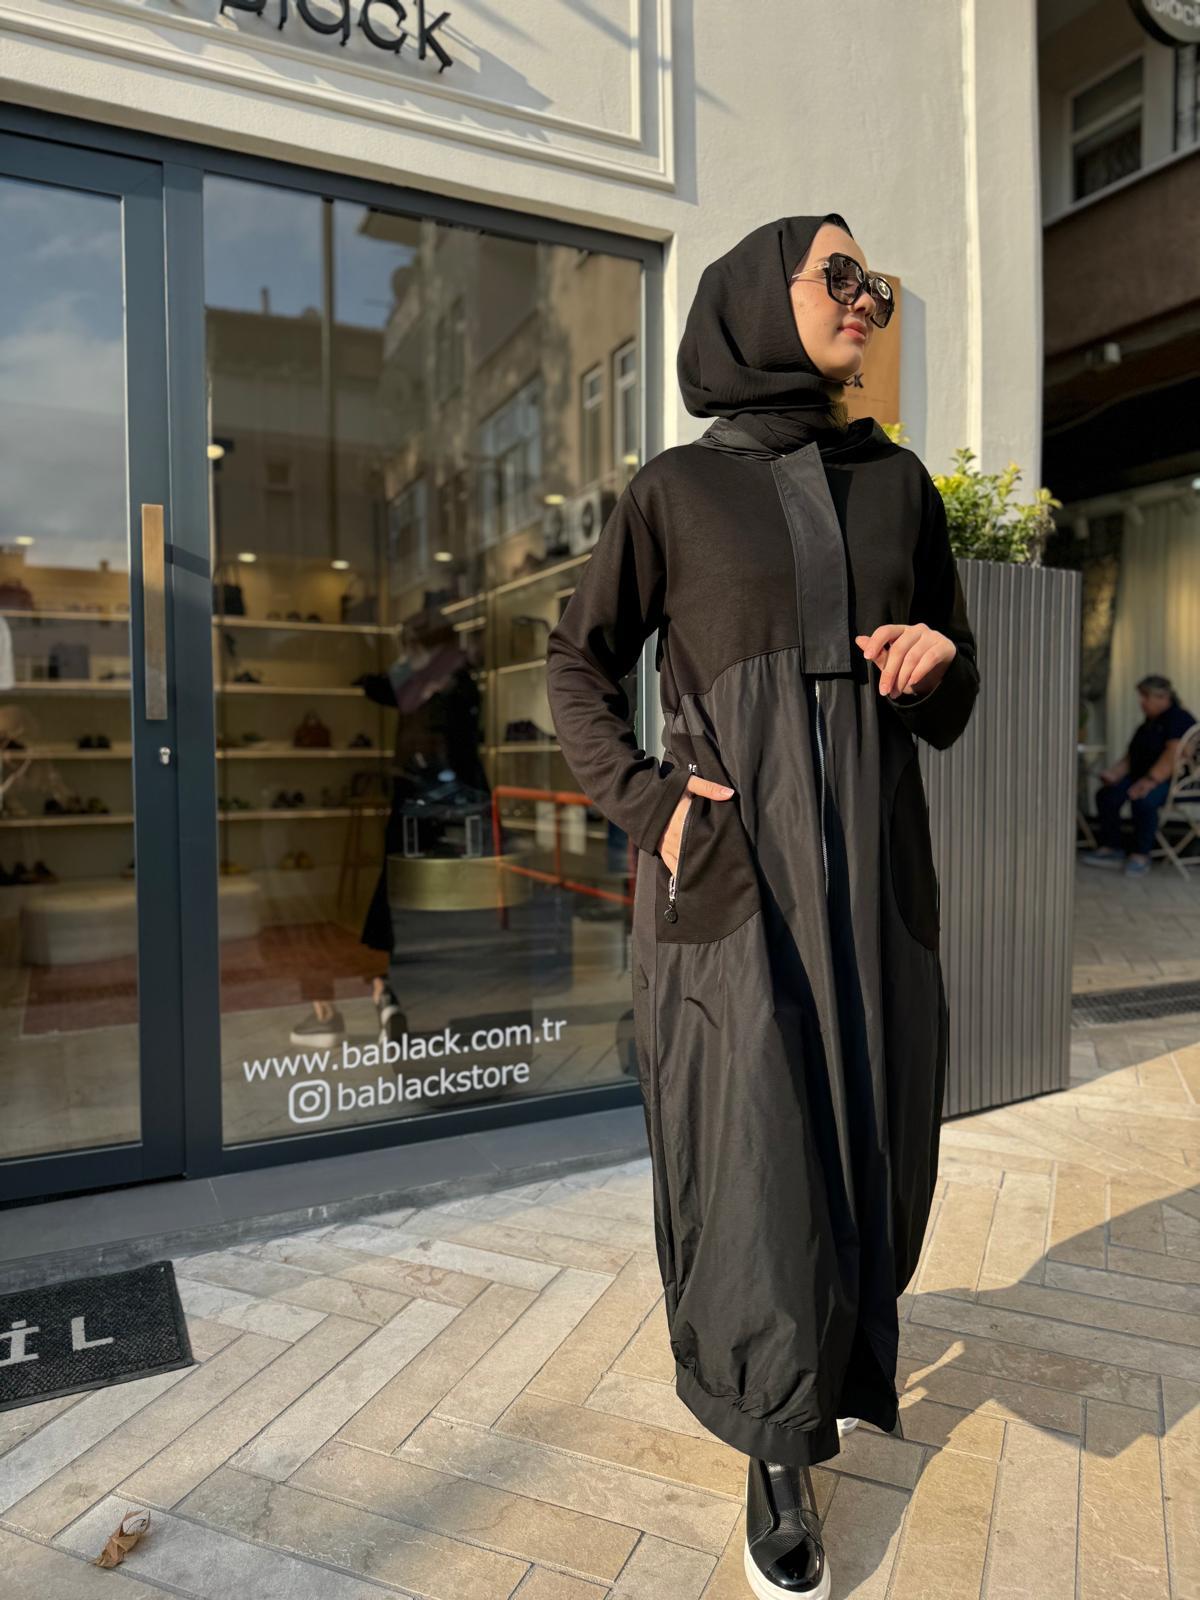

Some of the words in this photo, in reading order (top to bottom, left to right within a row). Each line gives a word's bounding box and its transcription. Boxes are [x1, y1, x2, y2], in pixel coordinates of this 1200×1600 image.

[219, 0, 453, 72] ack
[243, 1018, 567, 1082] www.bablack.com.tr
[338, 1062, 530, 1111] bablackstore
